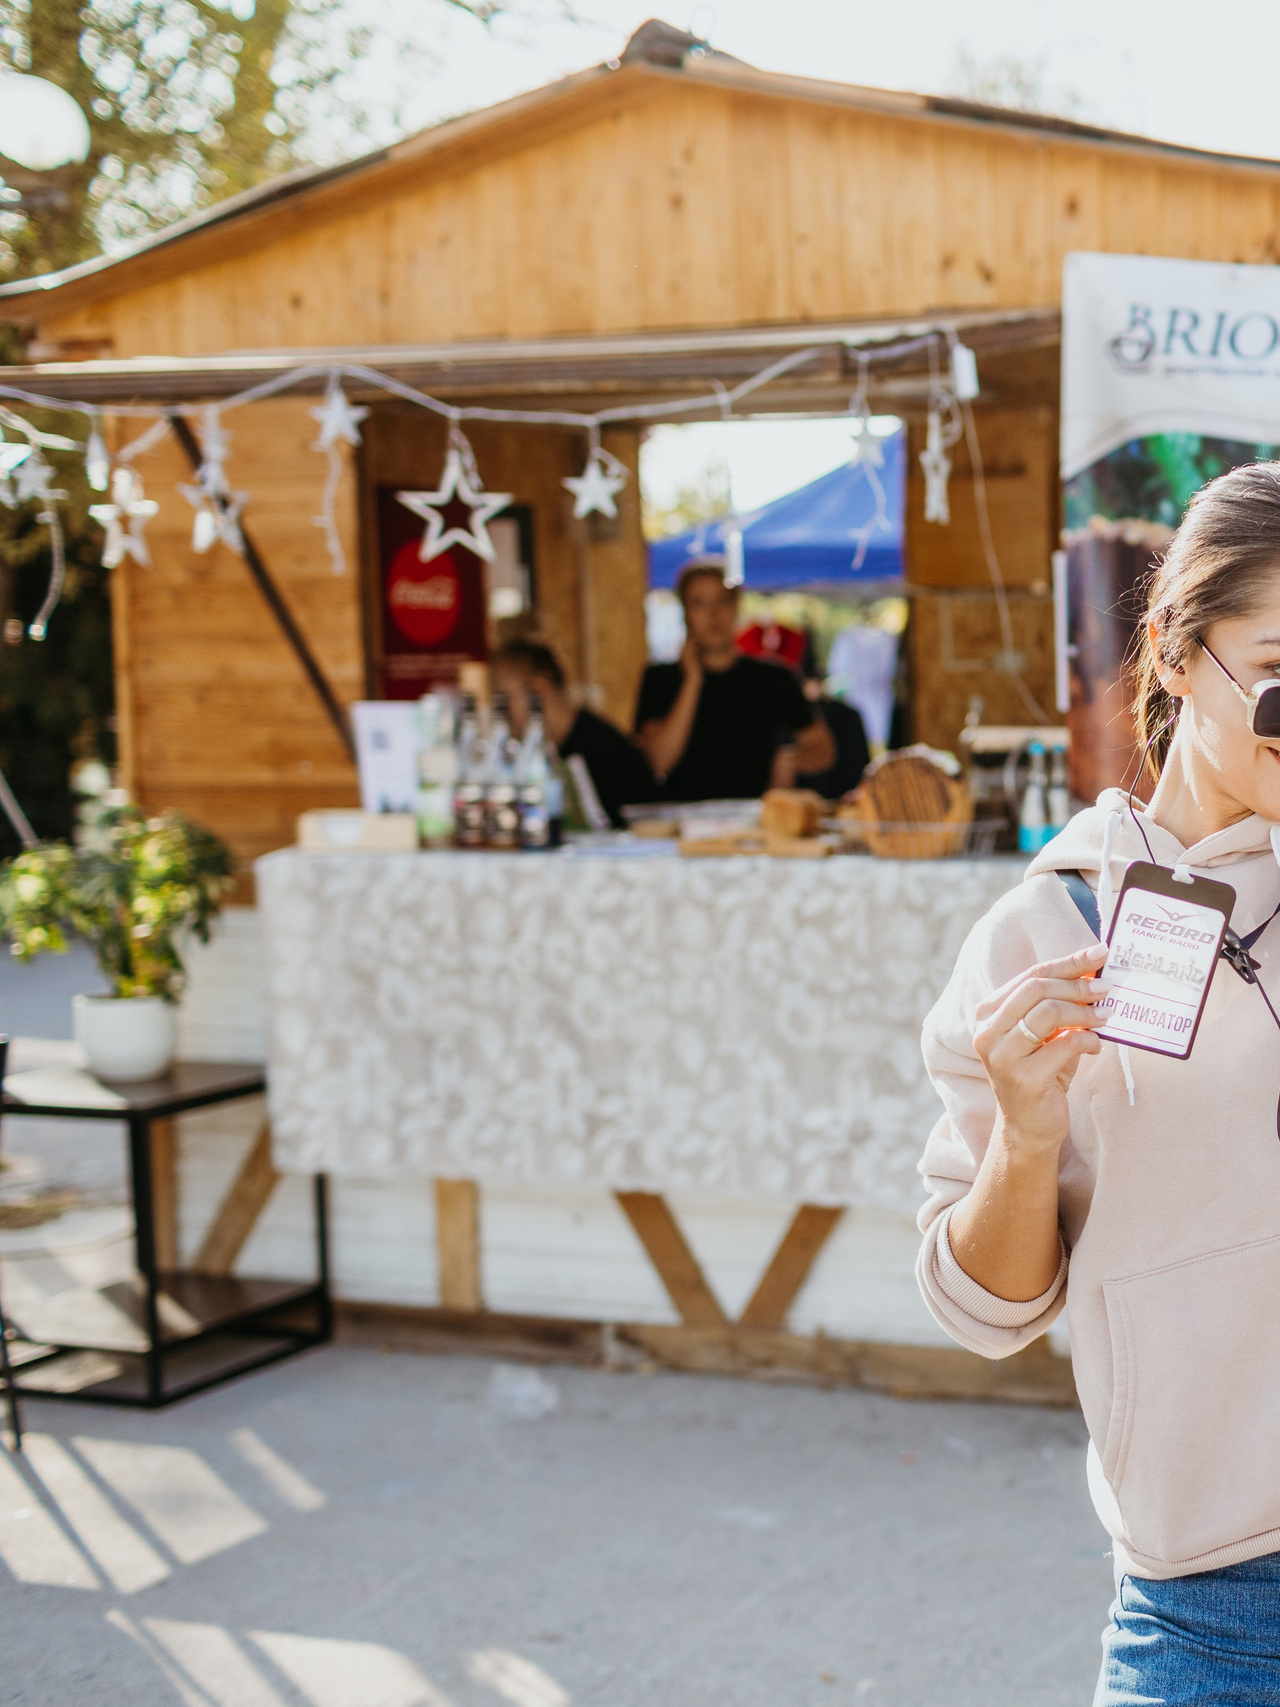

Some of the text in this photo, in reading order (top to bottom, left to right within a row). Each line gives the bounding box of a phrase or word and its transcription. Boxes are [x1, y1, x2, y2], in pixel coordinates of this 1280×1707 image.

[1126, 913, 1216, 944] RECORD
[1132, 928, 1200, 951] DANCE RADIO
[1113, 942, 1205, 983] HIGHLAND
